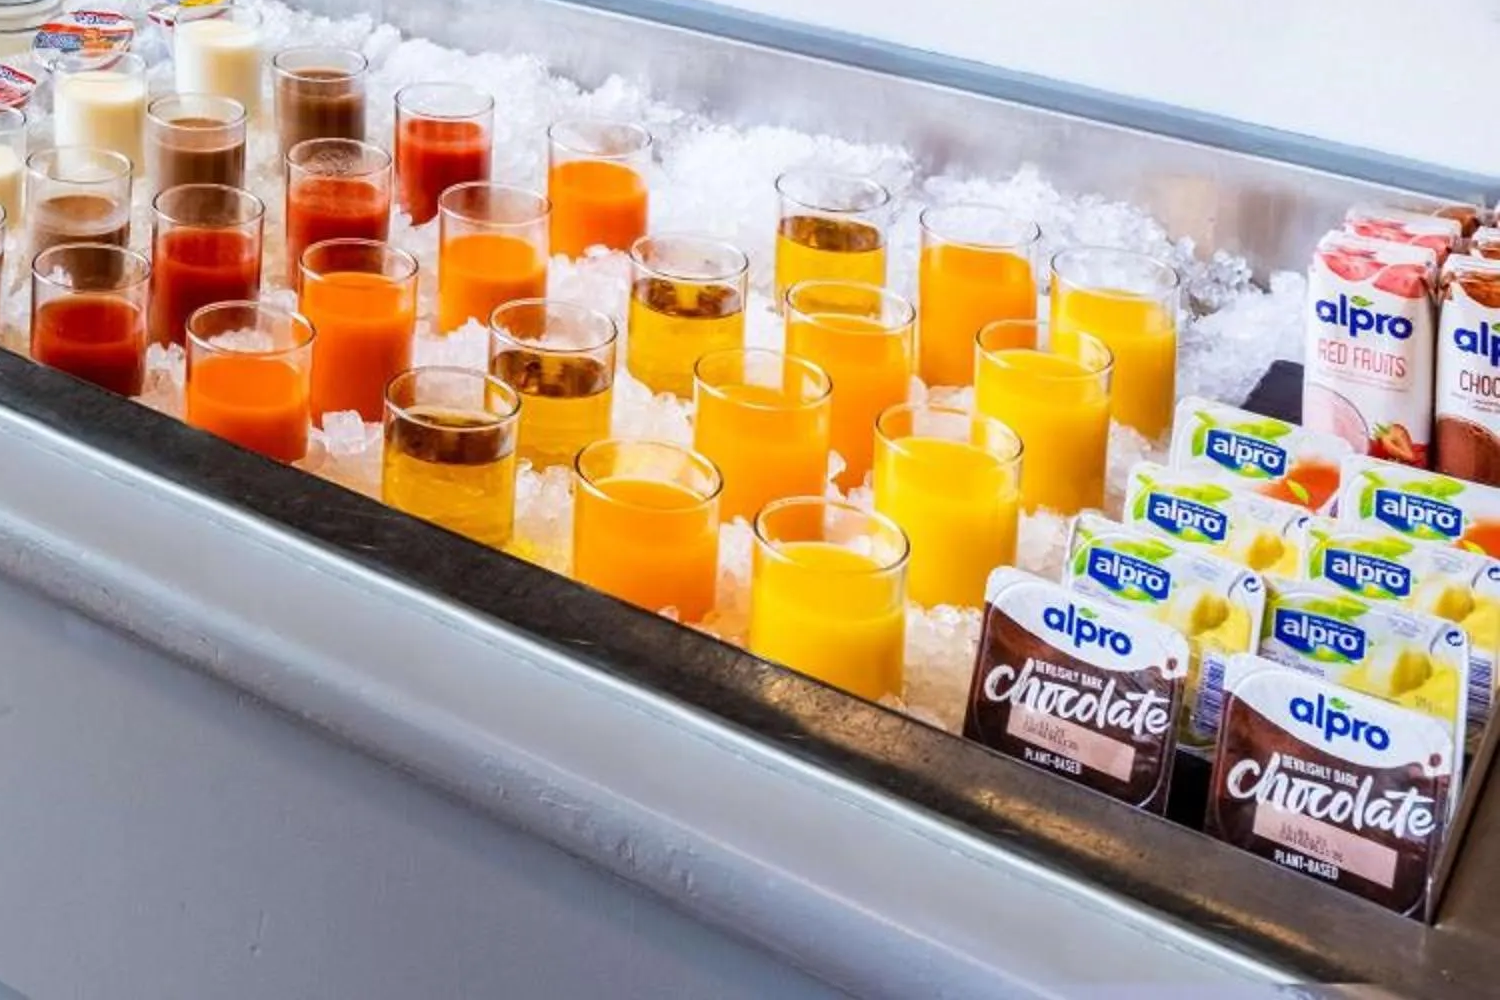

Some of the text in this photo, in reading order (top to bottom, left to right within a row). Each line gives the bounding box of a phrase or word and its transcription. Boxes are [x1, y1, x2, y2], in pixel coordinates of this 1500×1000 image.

[1315, 293, 1413, 340] alpro
[1318, 338, 1406, 378] RED FRUITS
[1213, 436, 1282, 469] alpro
[1153, 499, 1221, 533] alpro
[1382, 495, 1456, 529] alpro
[1095, 555, 1165, 591] alpro
[1331, 555, 1405, 588] alpro
[1043, 603, 1133, 656] alpro
[1282, 615, 1359, 652] alpro
[984, 657, 1171, 736] chocolate
[1289, 693, 1391, 751] alpro
[1024, 747, 1082, 775] PLANT-BASED
[1227, 752, 1437, 839] chocolate
[1274, 849, 1339, 881] PLANT-BASED
